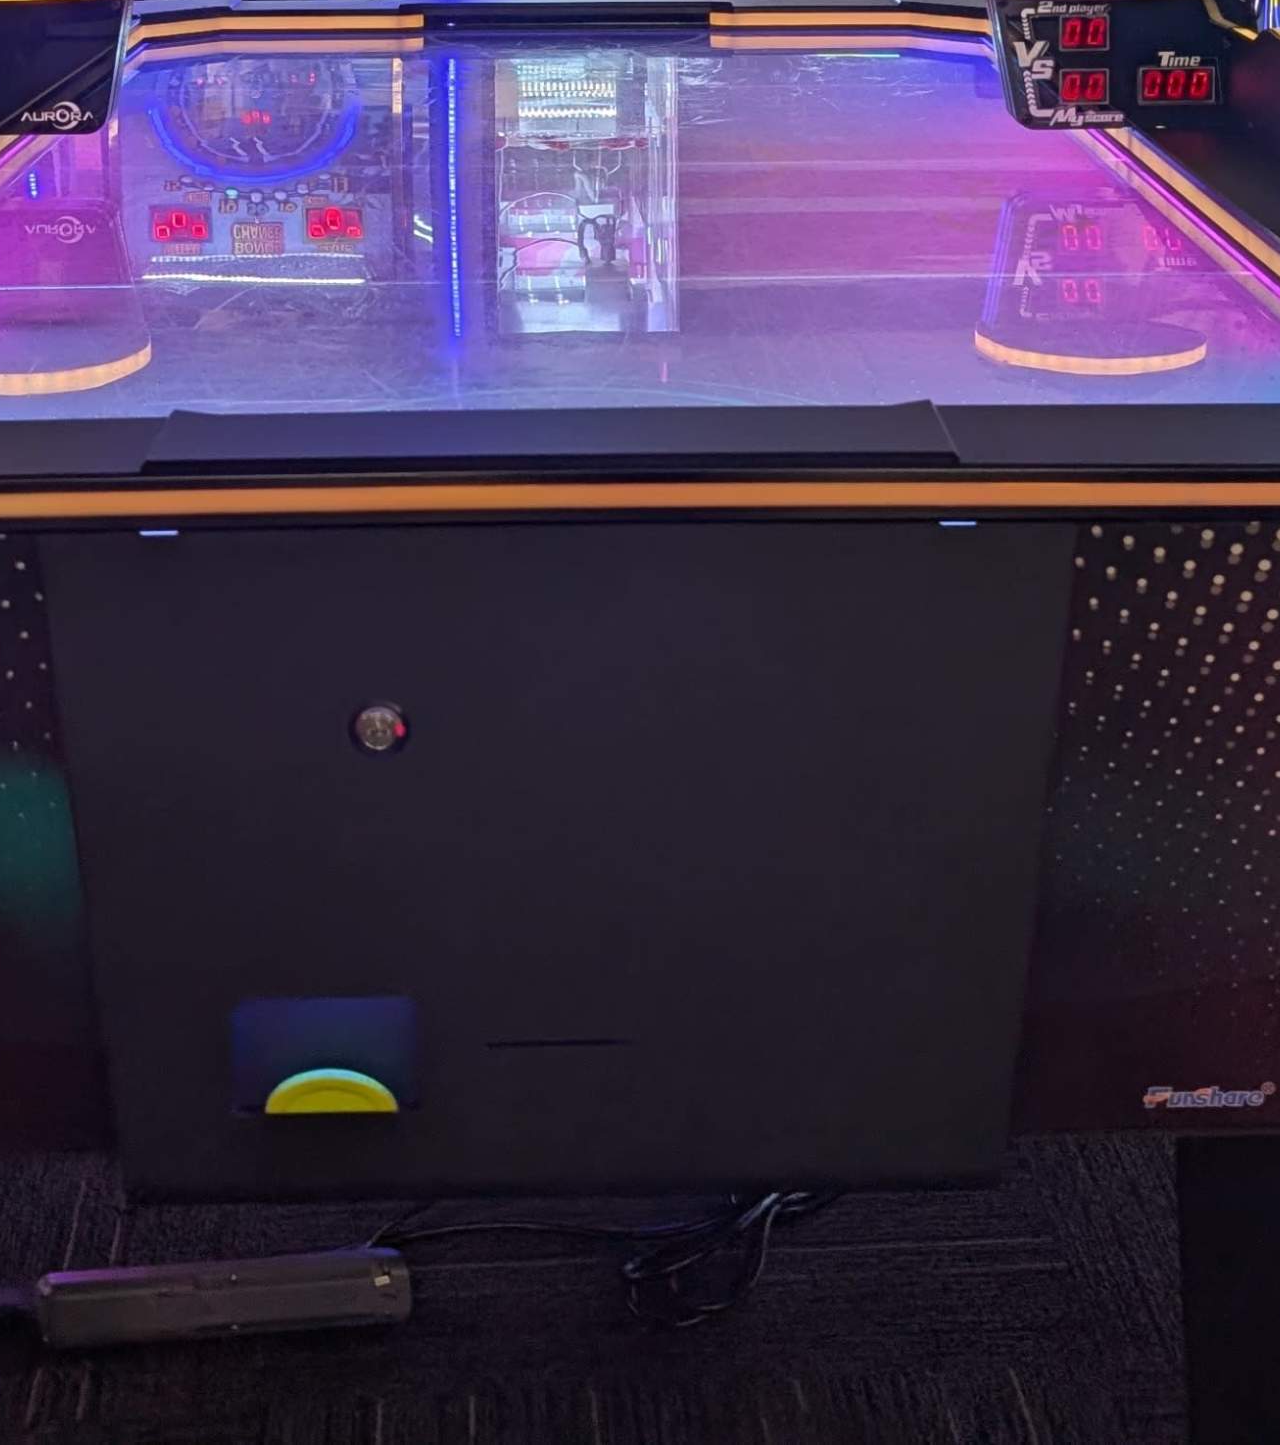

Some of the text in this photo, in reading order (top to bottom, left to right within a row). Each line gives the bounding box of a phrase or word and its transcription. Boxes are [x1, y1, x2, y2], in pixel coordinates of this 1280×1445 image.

[1037, 0, 1108, 16] 2nd player
[1062, 18, 1106, 47] 00
[1158, 50, 1201, 67] Time
[1060, 73, 1106, 101] 00
[1143, 70, 1210, 98] 000
[20, 101, 94, 131] AURORA
[1049, 107, 1085, 127] My
